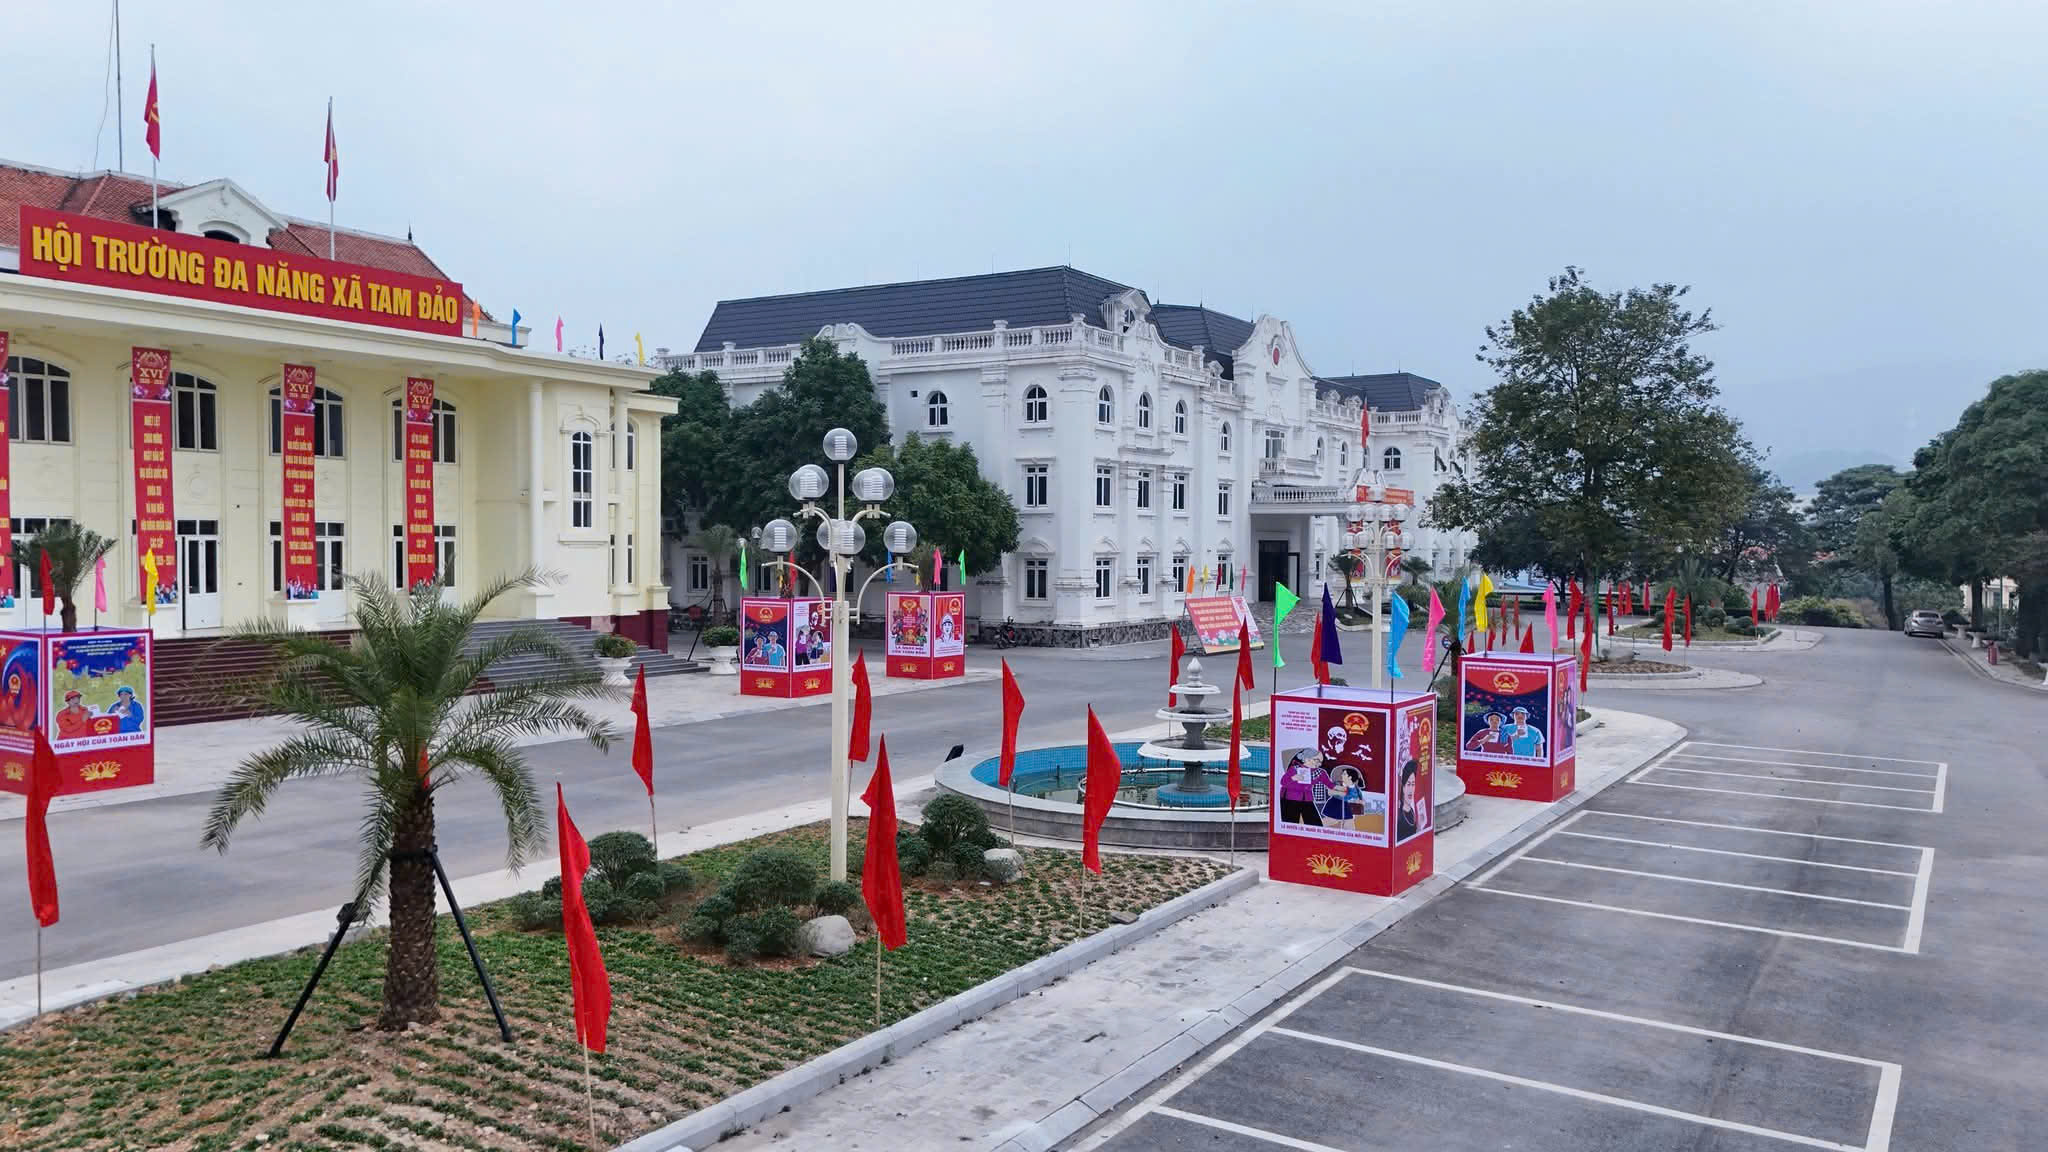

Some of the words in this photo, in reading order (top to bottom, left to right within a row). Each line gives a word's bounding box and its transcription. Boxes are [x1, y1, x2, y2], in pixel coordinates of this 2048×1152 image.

[32, 221, 83, 272] HỘI
[91, 235, 205, 285] TRƯỜNG
[213, 255, 249, 292] ĐA
[256, 260, 325, 304] NĂNG
[331, 273, 364, 310] XÃ
[368, 282, 412, 317] TAM
[418, 284, 458, 324] ĐẢO
[139, 367, 164, 379] XVI
[289, 383, 309, 393] XVI
